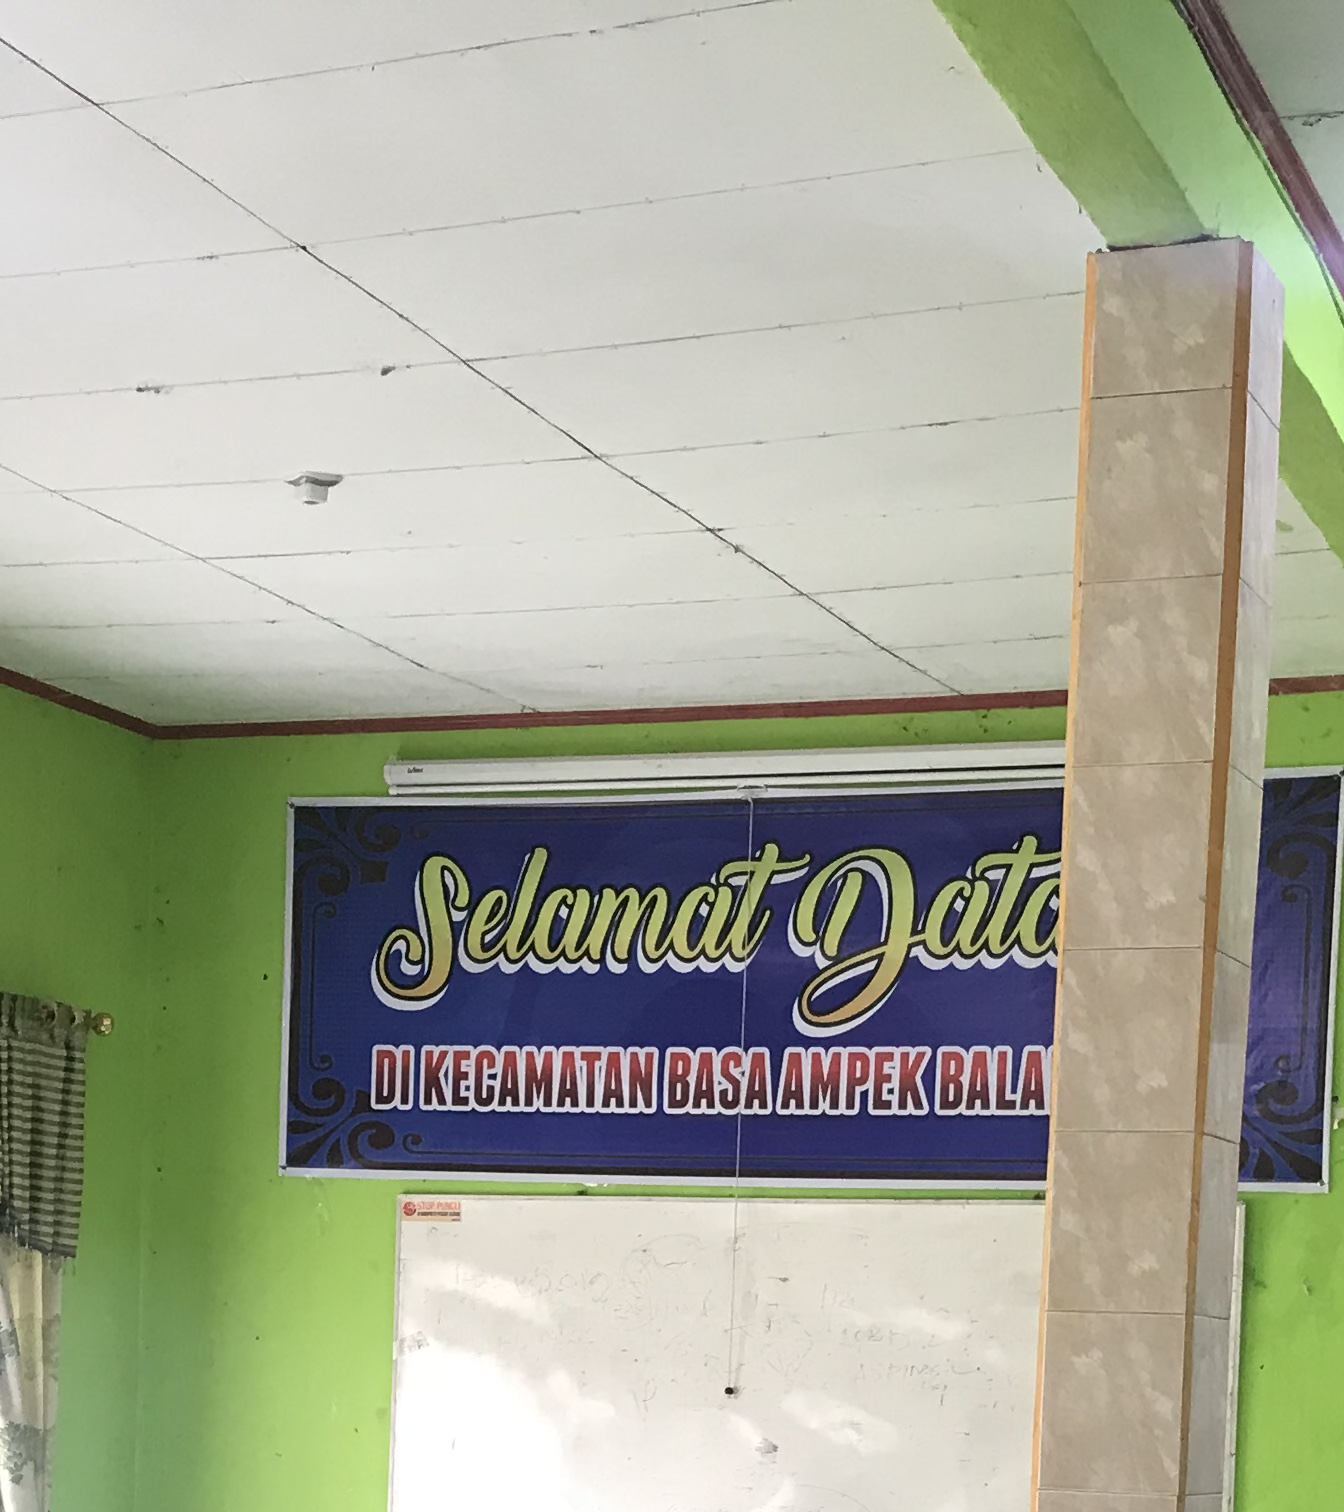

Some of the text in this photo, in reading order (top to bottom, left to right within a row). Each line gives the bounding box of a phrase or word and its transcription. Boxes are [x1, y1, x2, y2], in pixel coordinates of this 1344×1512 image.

[371, 842, 811, 1010] Selamat
[371, 1045, 414, 1110] DI
[419, 1045, 659, 1113] KECAMATAN
[663, 1046, 771, 1115] BASA
[776, 1046, 932, 1116] AMPEK
